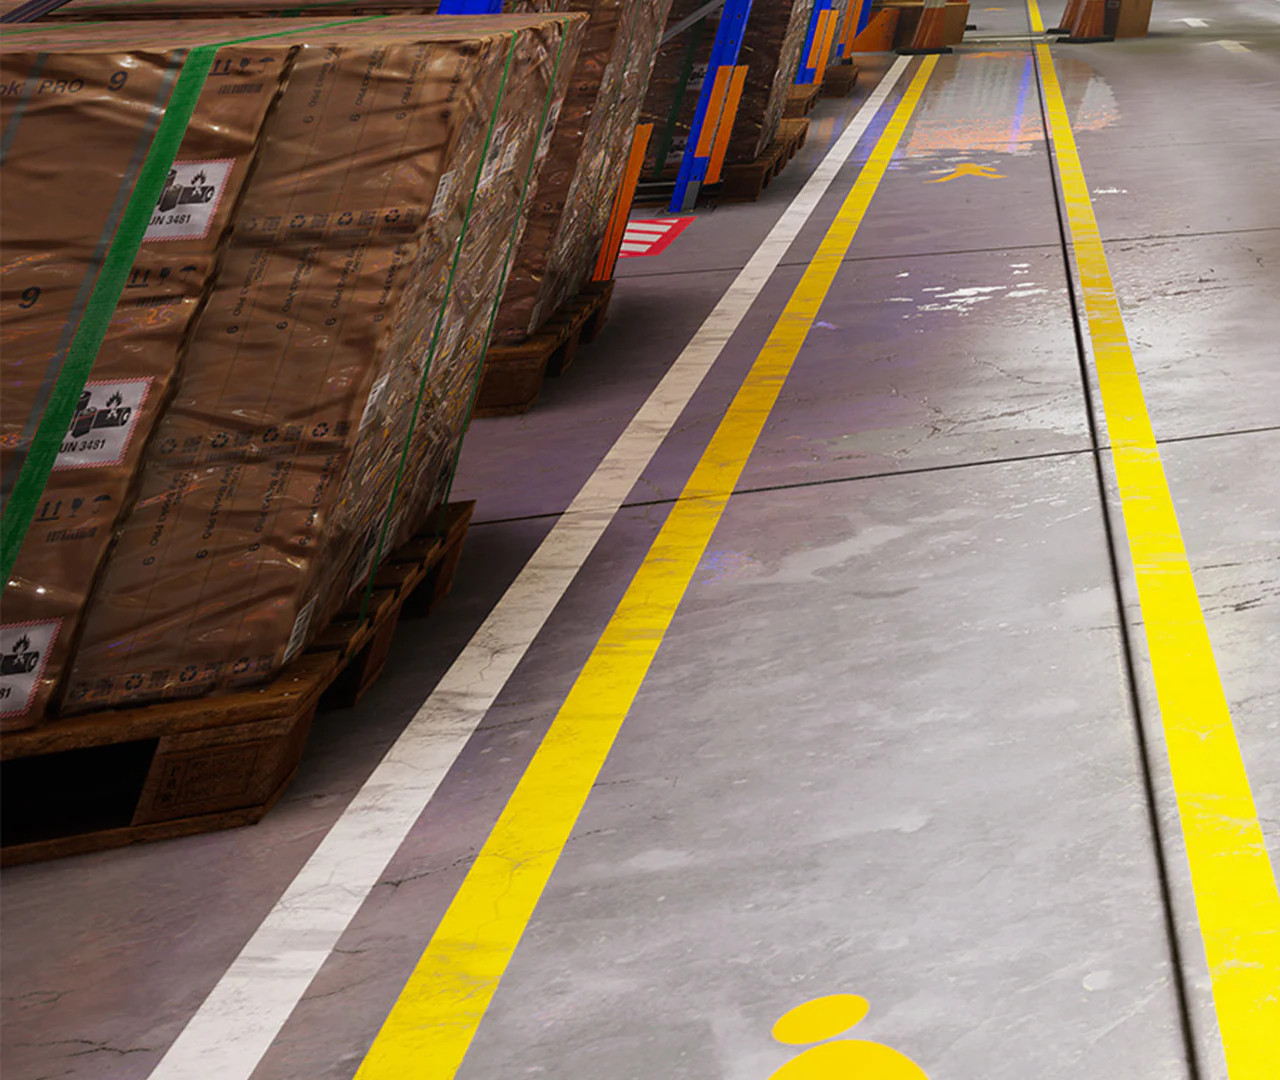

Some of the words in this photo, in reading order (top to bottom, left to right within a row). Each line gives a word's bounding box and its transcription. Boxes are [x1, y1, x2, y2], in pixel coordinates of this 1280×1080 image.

[38, 79, 84, 95] PRO
[108, 71, 128, 93] 9
[165, 213, 192, 226] 3481
[18, 286, 41, 309] 9
[59, 441, 79, 454] UN
[79, 438, 107, 452] 3481
